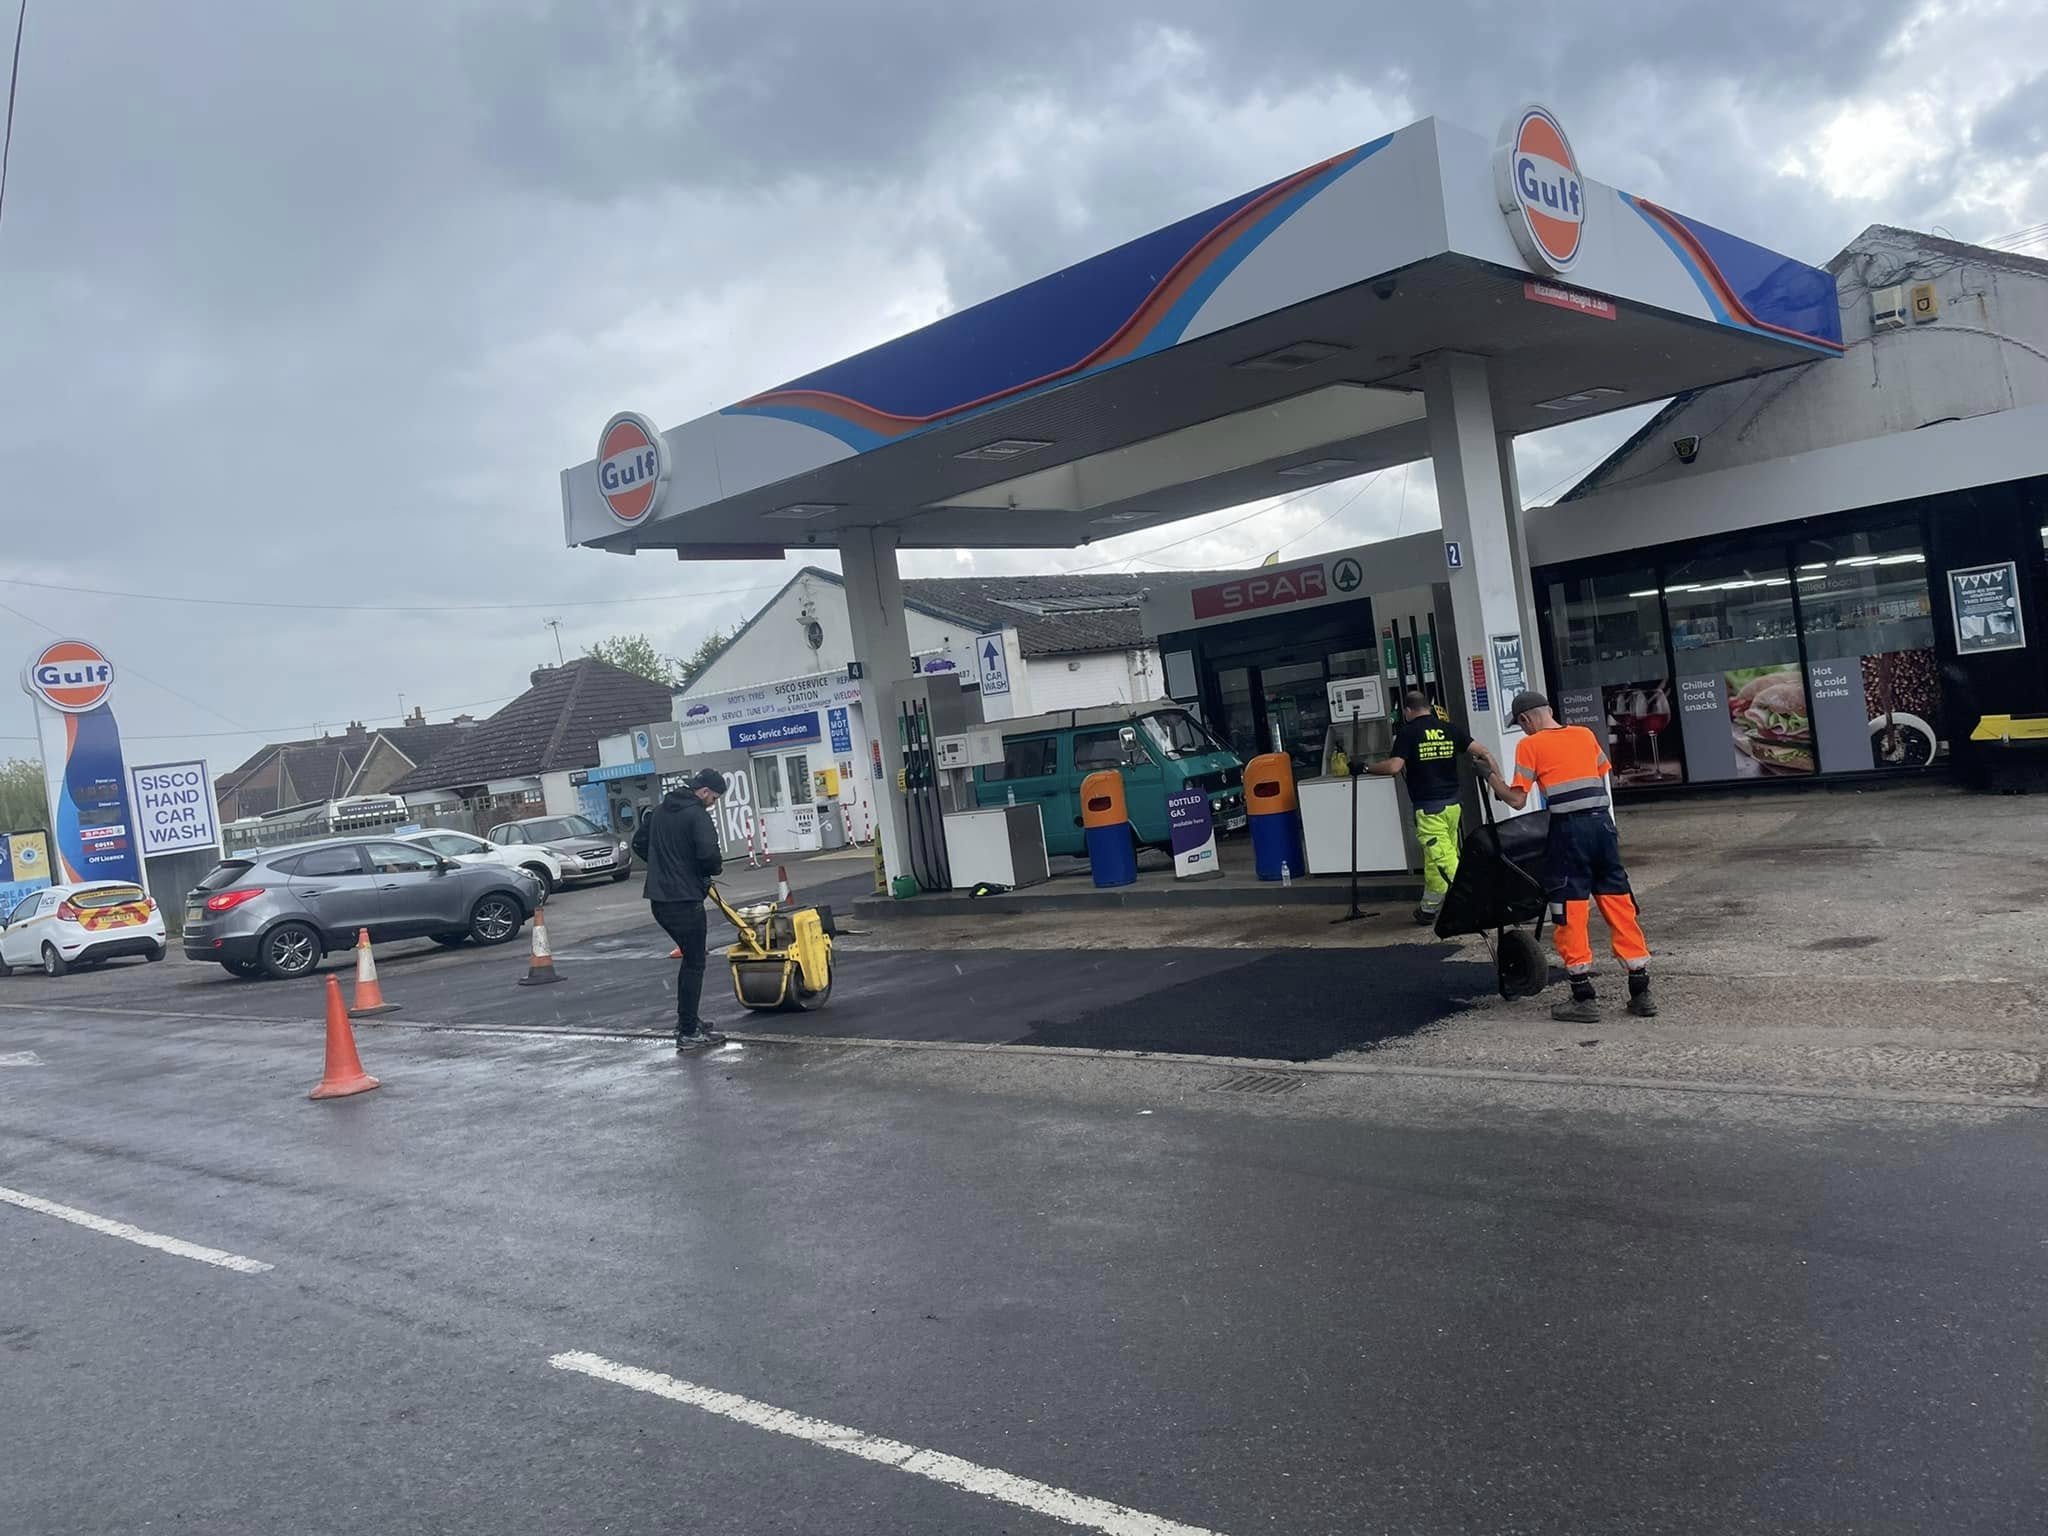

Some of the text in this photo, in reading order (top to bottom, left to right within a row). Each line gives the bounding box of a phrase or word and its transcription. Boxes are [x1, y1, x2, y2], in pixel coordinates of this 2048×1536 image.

[1518, 158, 1580, 216] Gulf
[601, 451, 655, 490] Gulf
[1449, 545, 1458, 564] 2
[1221, 568, 1325, 609] SPAR
[37, 665, 109, 685] Gulf
[851, 664, 860, 678] 4
[985, 671, 1003, 682] CAR
[1812, 666, 1832, 676] Hot
[774, 676, 829, 696] SISCO SERVICE
[984, 681, 1008, 692] WASH
[1682, 680, 1715, 690] Chilled
[1814, 675, 1847, 688] & cold
[786, 690, 819, 704] STATION
[1563, 694, 1593, 705] Chilled
[1683, 691, 1715, 701] food &
[1815, 688, 1849, 699] drinks
[1684, 701, 1718, 712] snacks
[830, 719, 848, 729] MOT
[739, 724, 808, 743] Sisco Service Station
[1424, 729, 1445, 741] MC
[140, 771, 199, 791] SISCO
[721, 770, 751, 808] 20
[145, 789, 200, 808] HAND
[1168, 795, 1201, 808] BOTTLED
[155, 807, 196, 825] CAR
[1170, 808, 1187, 818] GAS
[725, 805, 757, 841] KG
[85, 828, 113, 838] SPAR
[150, 823, 207, 844] WASH
[94, 840, 115, 849] COSTA
[88, 854, 125, 864] Off Licence
